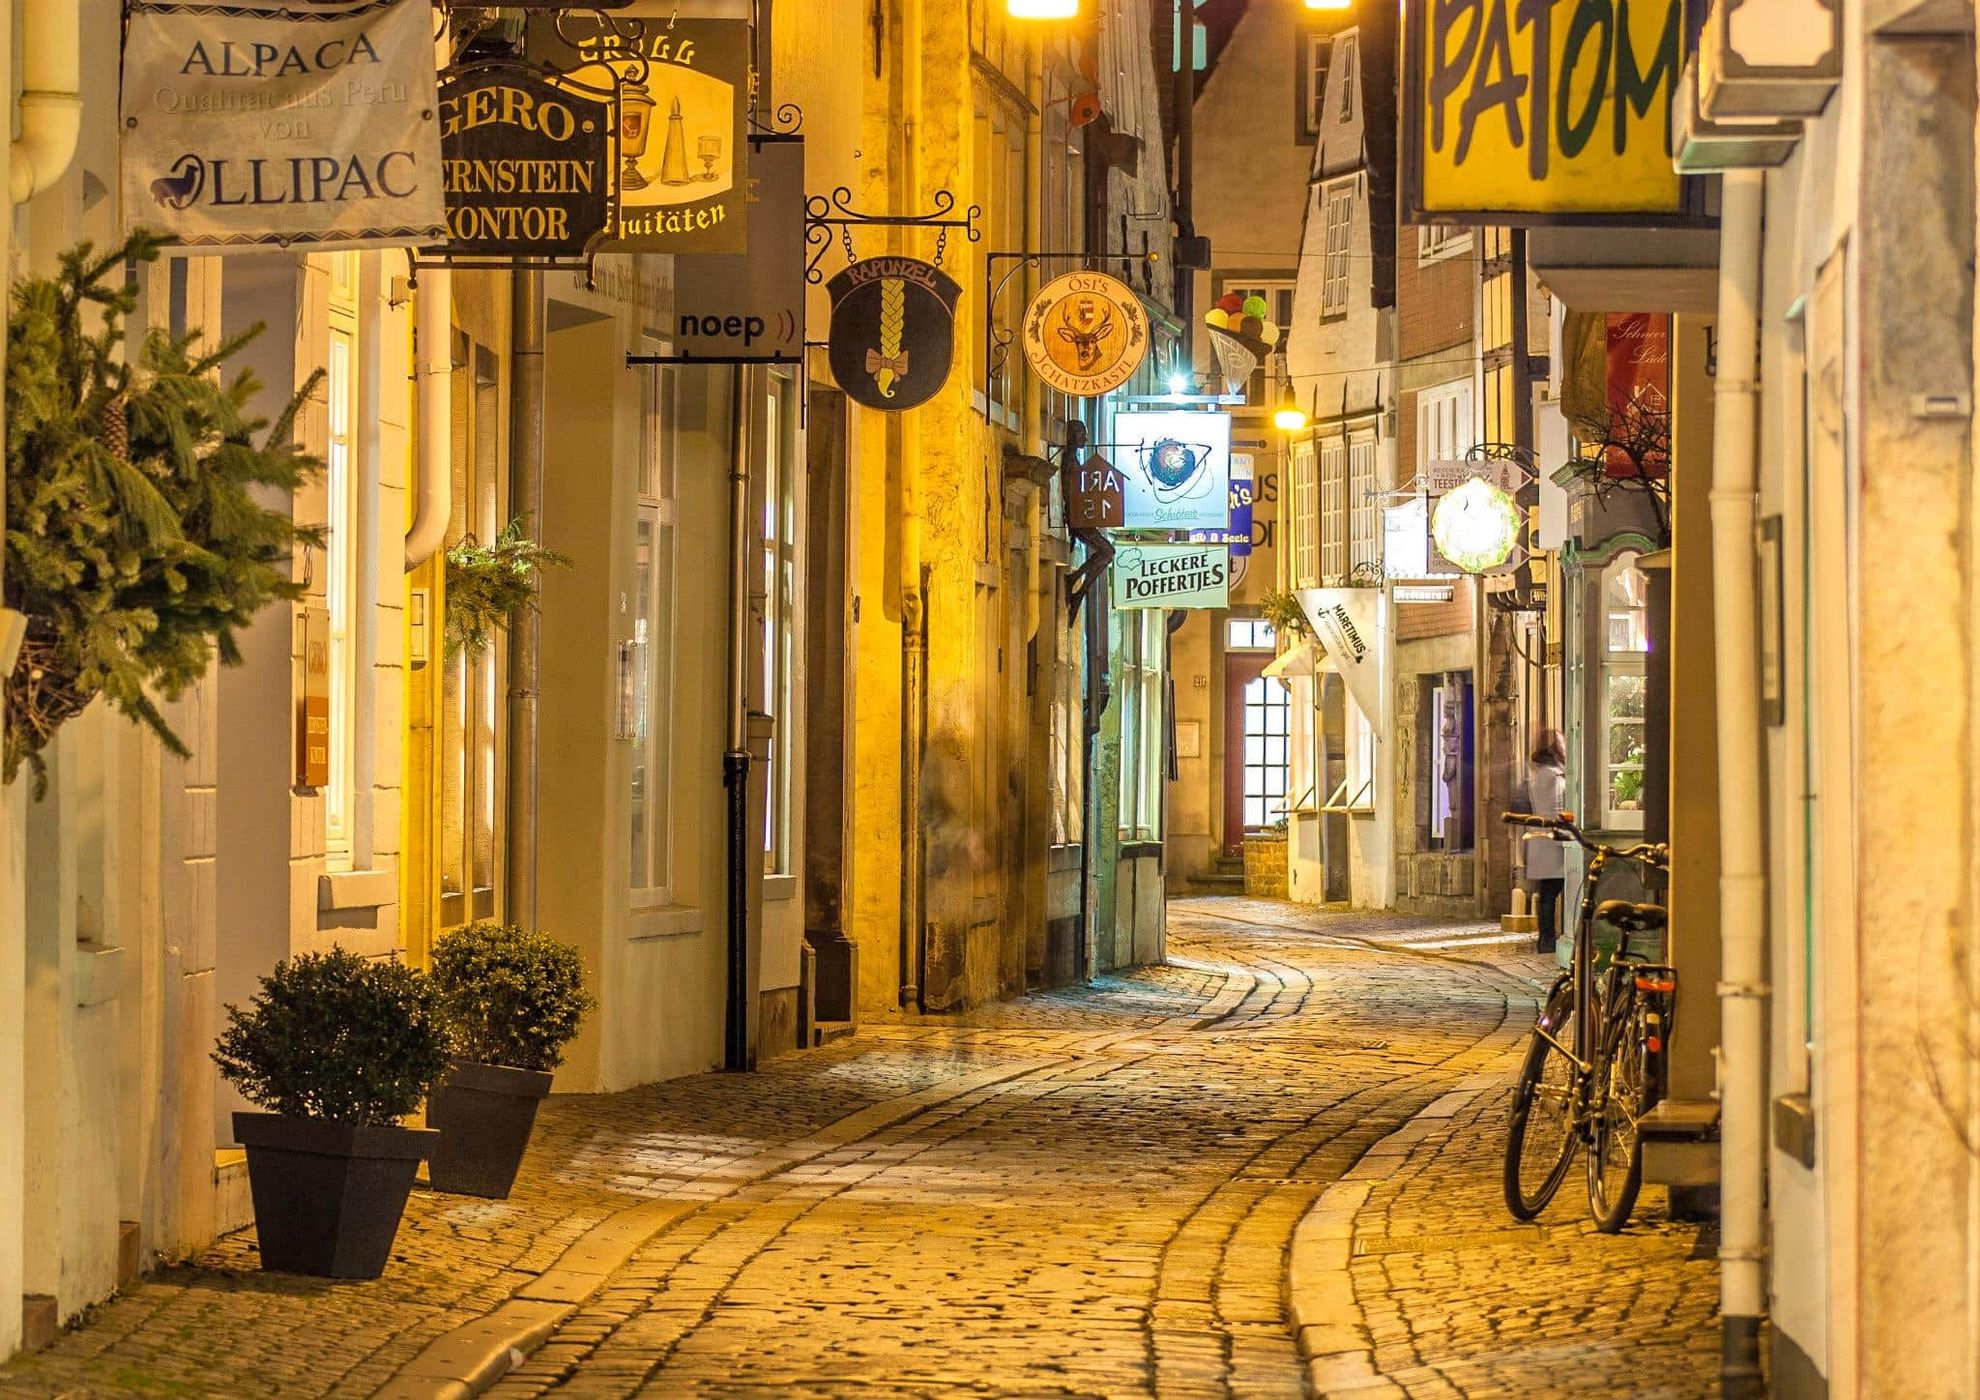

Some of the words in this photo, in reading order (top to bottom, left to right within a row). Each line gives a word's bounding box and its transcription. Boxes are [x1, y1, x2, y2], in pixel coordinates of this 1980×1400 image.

[179, 32, 380, 77] ALPACA
[347, 81, 409, 106] Peru
[260, 120, 311, 140] von
[440, 86, 576, 142] GERO
[846, 259, 938, 289] RAPUNZEL
[680, 314, 765, 347] noep
[1030, 352, 1134, 391] SCHATZKASTL
[1126, 564, 1224, 599] POFFERTJES
[1141, 554, 1209, 577] LECKERE
[1333, 603, 1366, 654] MARETIMUS
